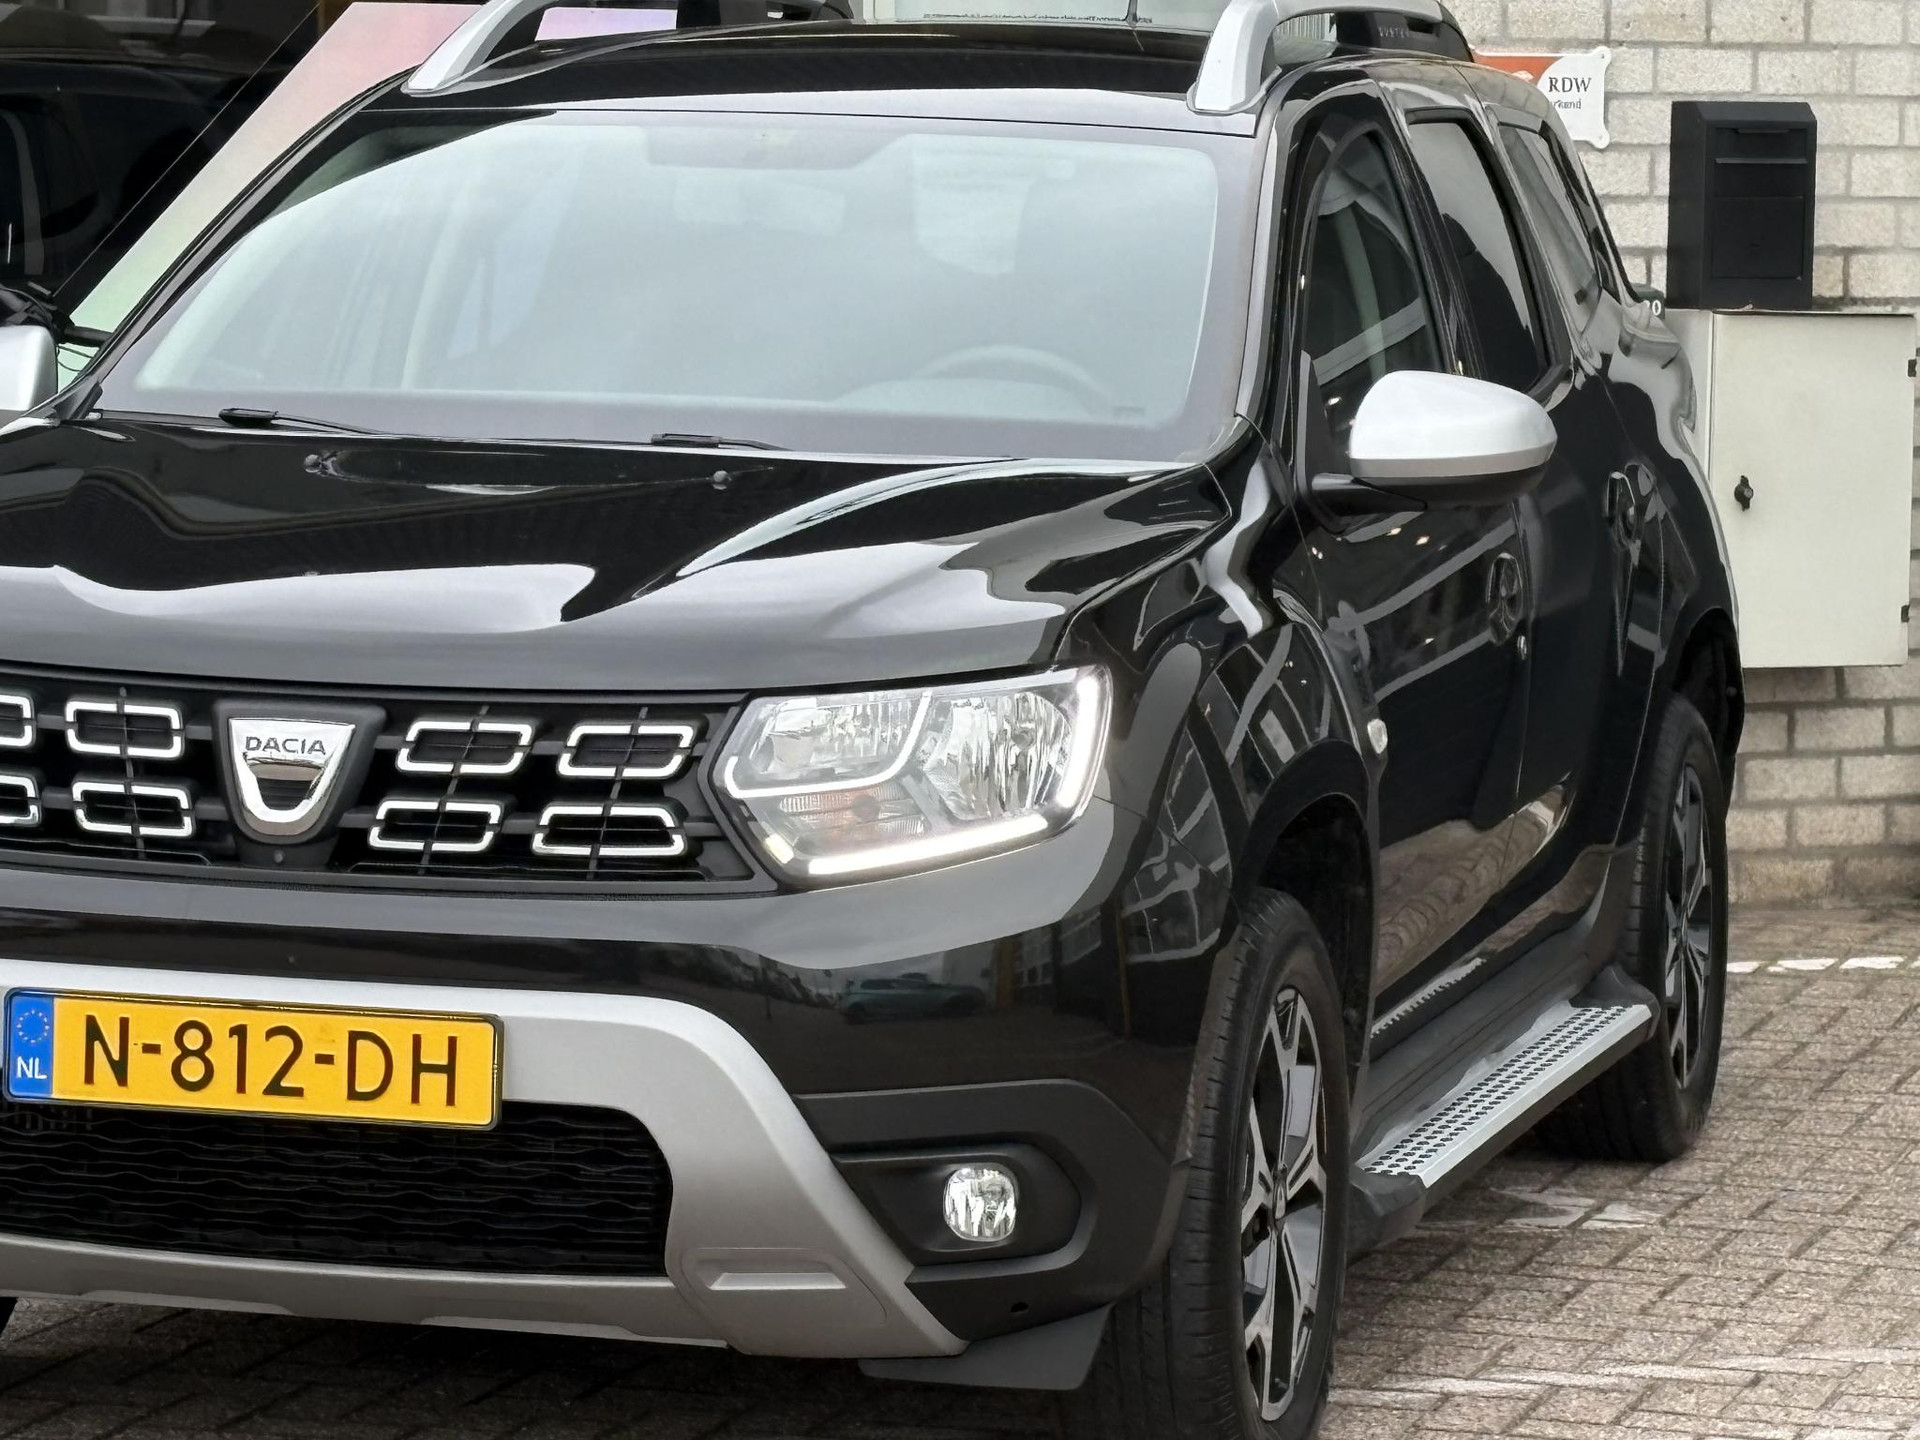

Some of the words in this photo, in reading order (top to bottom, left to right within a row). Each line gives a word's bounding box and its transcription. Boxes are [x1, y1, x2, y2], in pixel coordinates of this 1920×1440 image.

[1548, 76, 1592, 93] RDW
[245, 736, 326, 755] DACIA
[15, 1055, 47, 1080] NL
[83, 1013, 458, 1107] N-812-DH
